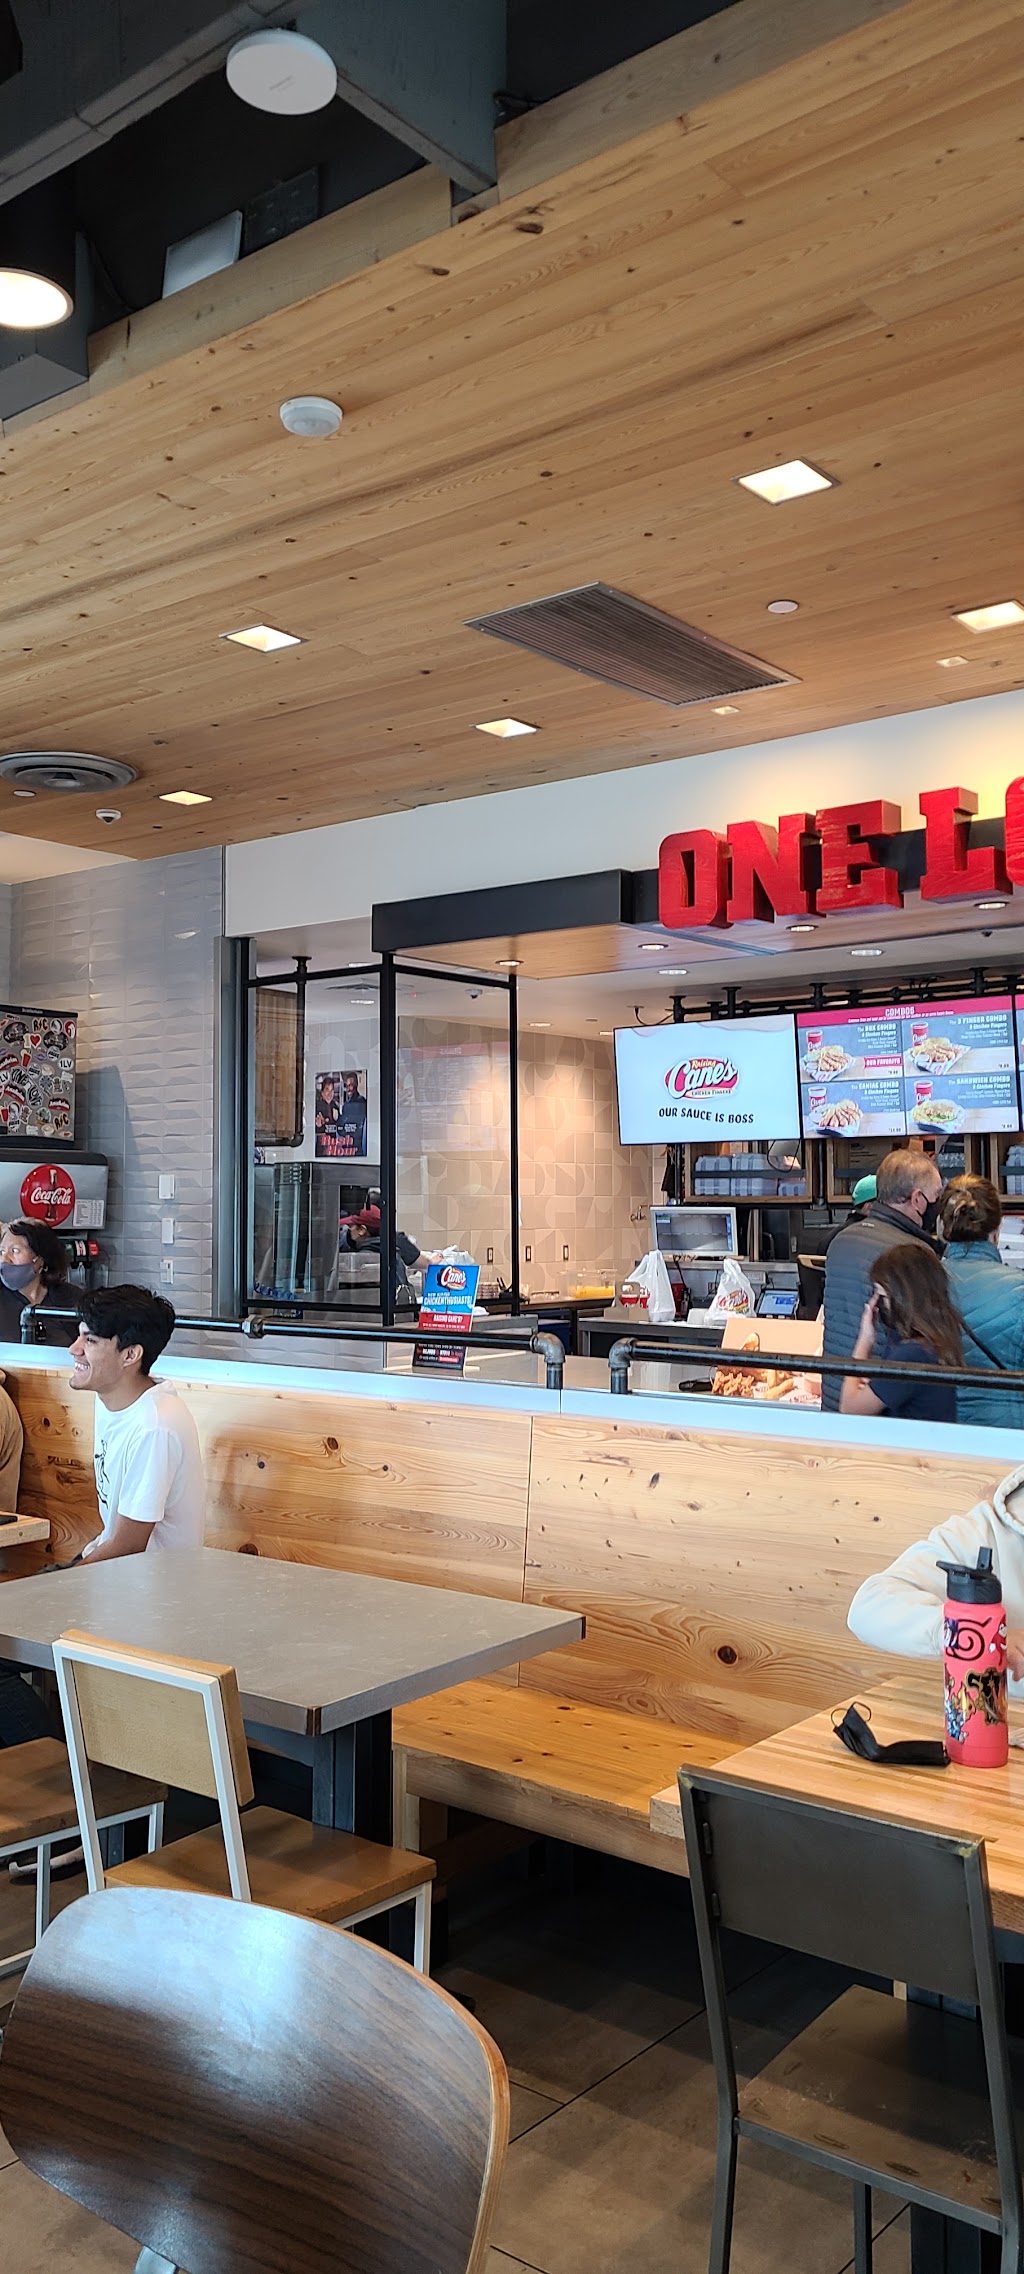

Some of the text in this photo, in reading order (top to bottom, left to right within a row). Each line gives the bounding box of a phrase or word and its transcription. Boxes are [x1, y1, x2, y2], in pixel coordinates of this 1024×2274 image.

[659, 799, 904, 930] ONE
[986, 1014, 1007, 1022] COMBO
[60, 1060, 72, 1068] 1LV
[692, 1060, 716, 1069] Raising
[668, 1057, 738, 1099] Cane's
[989, 1075, 1011, 1083] COMBO
[658, 1107, 754, 1123] OUR SAUCE IS BOSS
[321, 1135, 353, 1146] Rush
[326, 1145, 358, 1156] Hour
